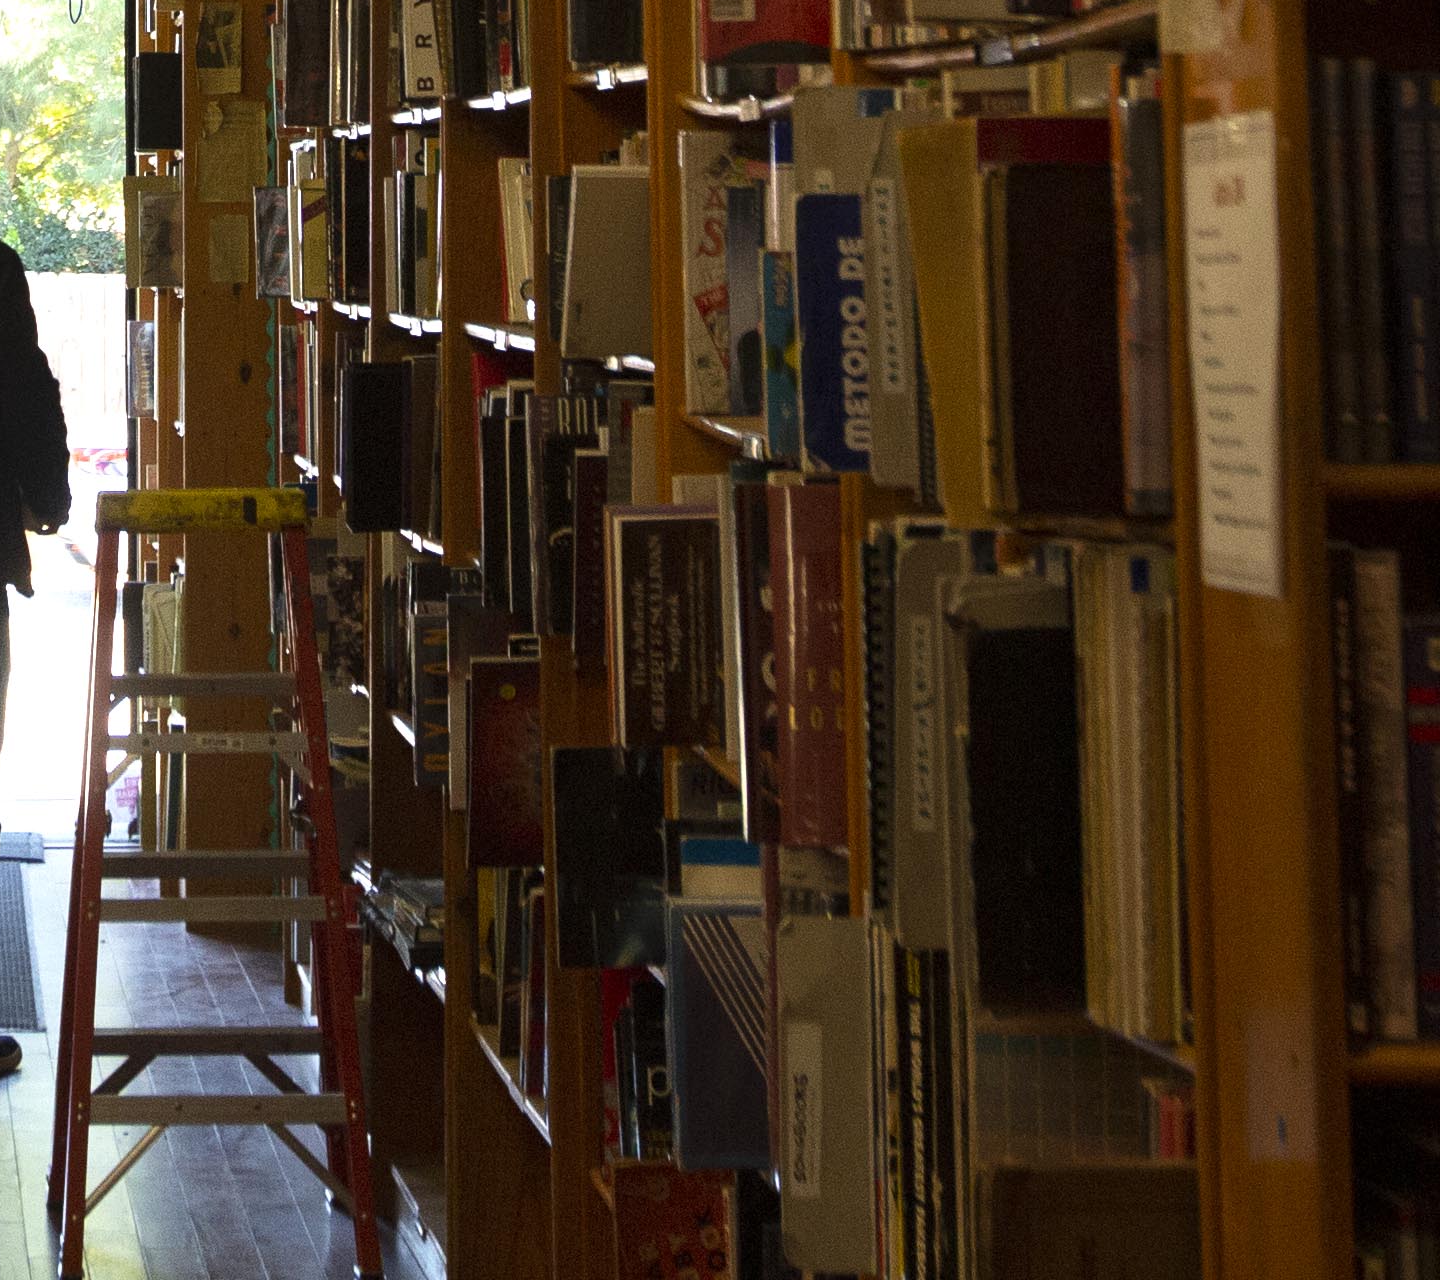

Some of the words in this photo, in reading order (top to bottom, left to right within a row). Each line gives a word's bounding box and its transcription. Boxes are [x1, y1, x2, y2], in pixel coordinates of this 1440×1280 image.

[837, 236, 865, 281] DE
[840, 296, 872, 453] METODO
[648, 533, 664, 627] SULLIVAN
[649, 649, 666, 731] GILBERT
